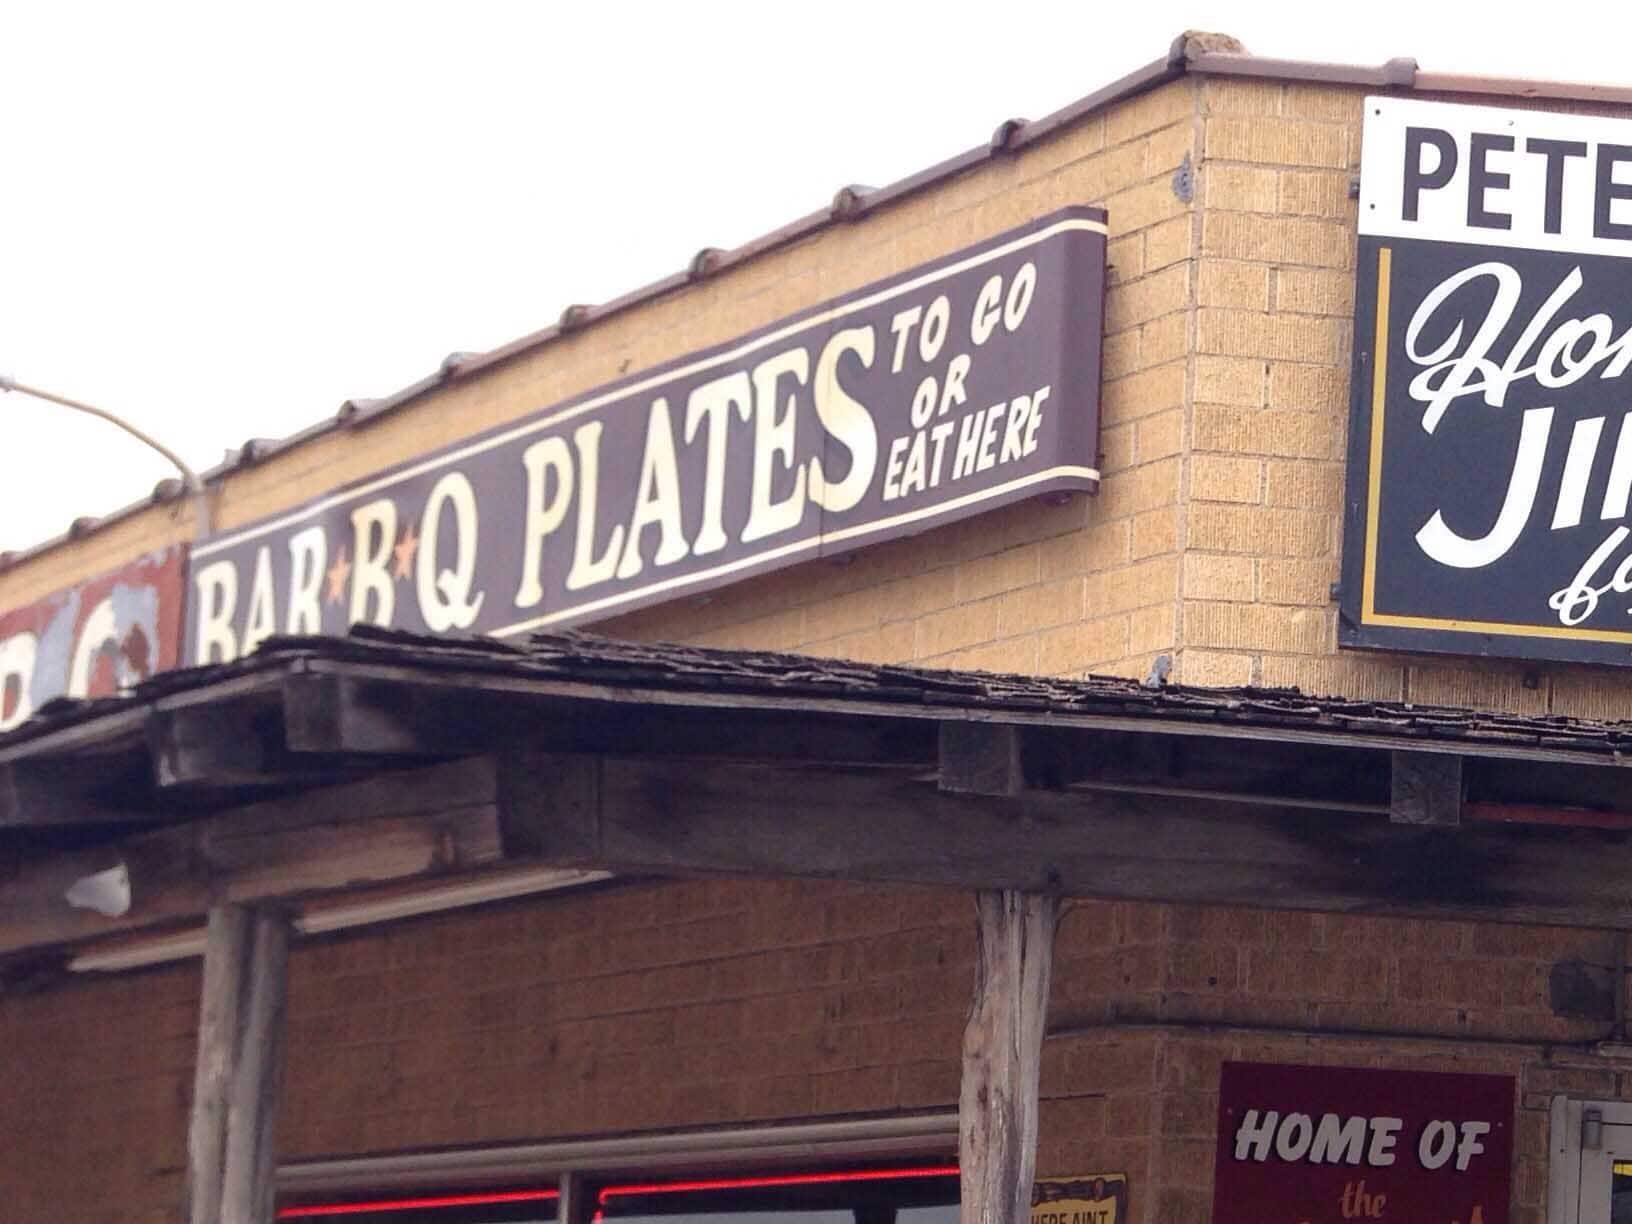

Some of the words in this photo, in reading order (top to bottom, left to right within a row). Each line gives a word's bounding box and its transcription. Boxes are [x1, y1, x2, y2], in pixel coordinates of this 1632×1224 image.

[889, 309, 948, 373] TO
[972, 262, 1036, 346] GO
[910, 355, 968, 428] OR
[517, 323, 879, 606] PLATES
[884, 427, 955, 500] EAT
[951, 386, 1049, 479] HERE
[1235, 1110, 1401, 1167] HOME
[1419, 1120, 1490, 1170] OF
[1338, 1180, 1386, 1220] the
